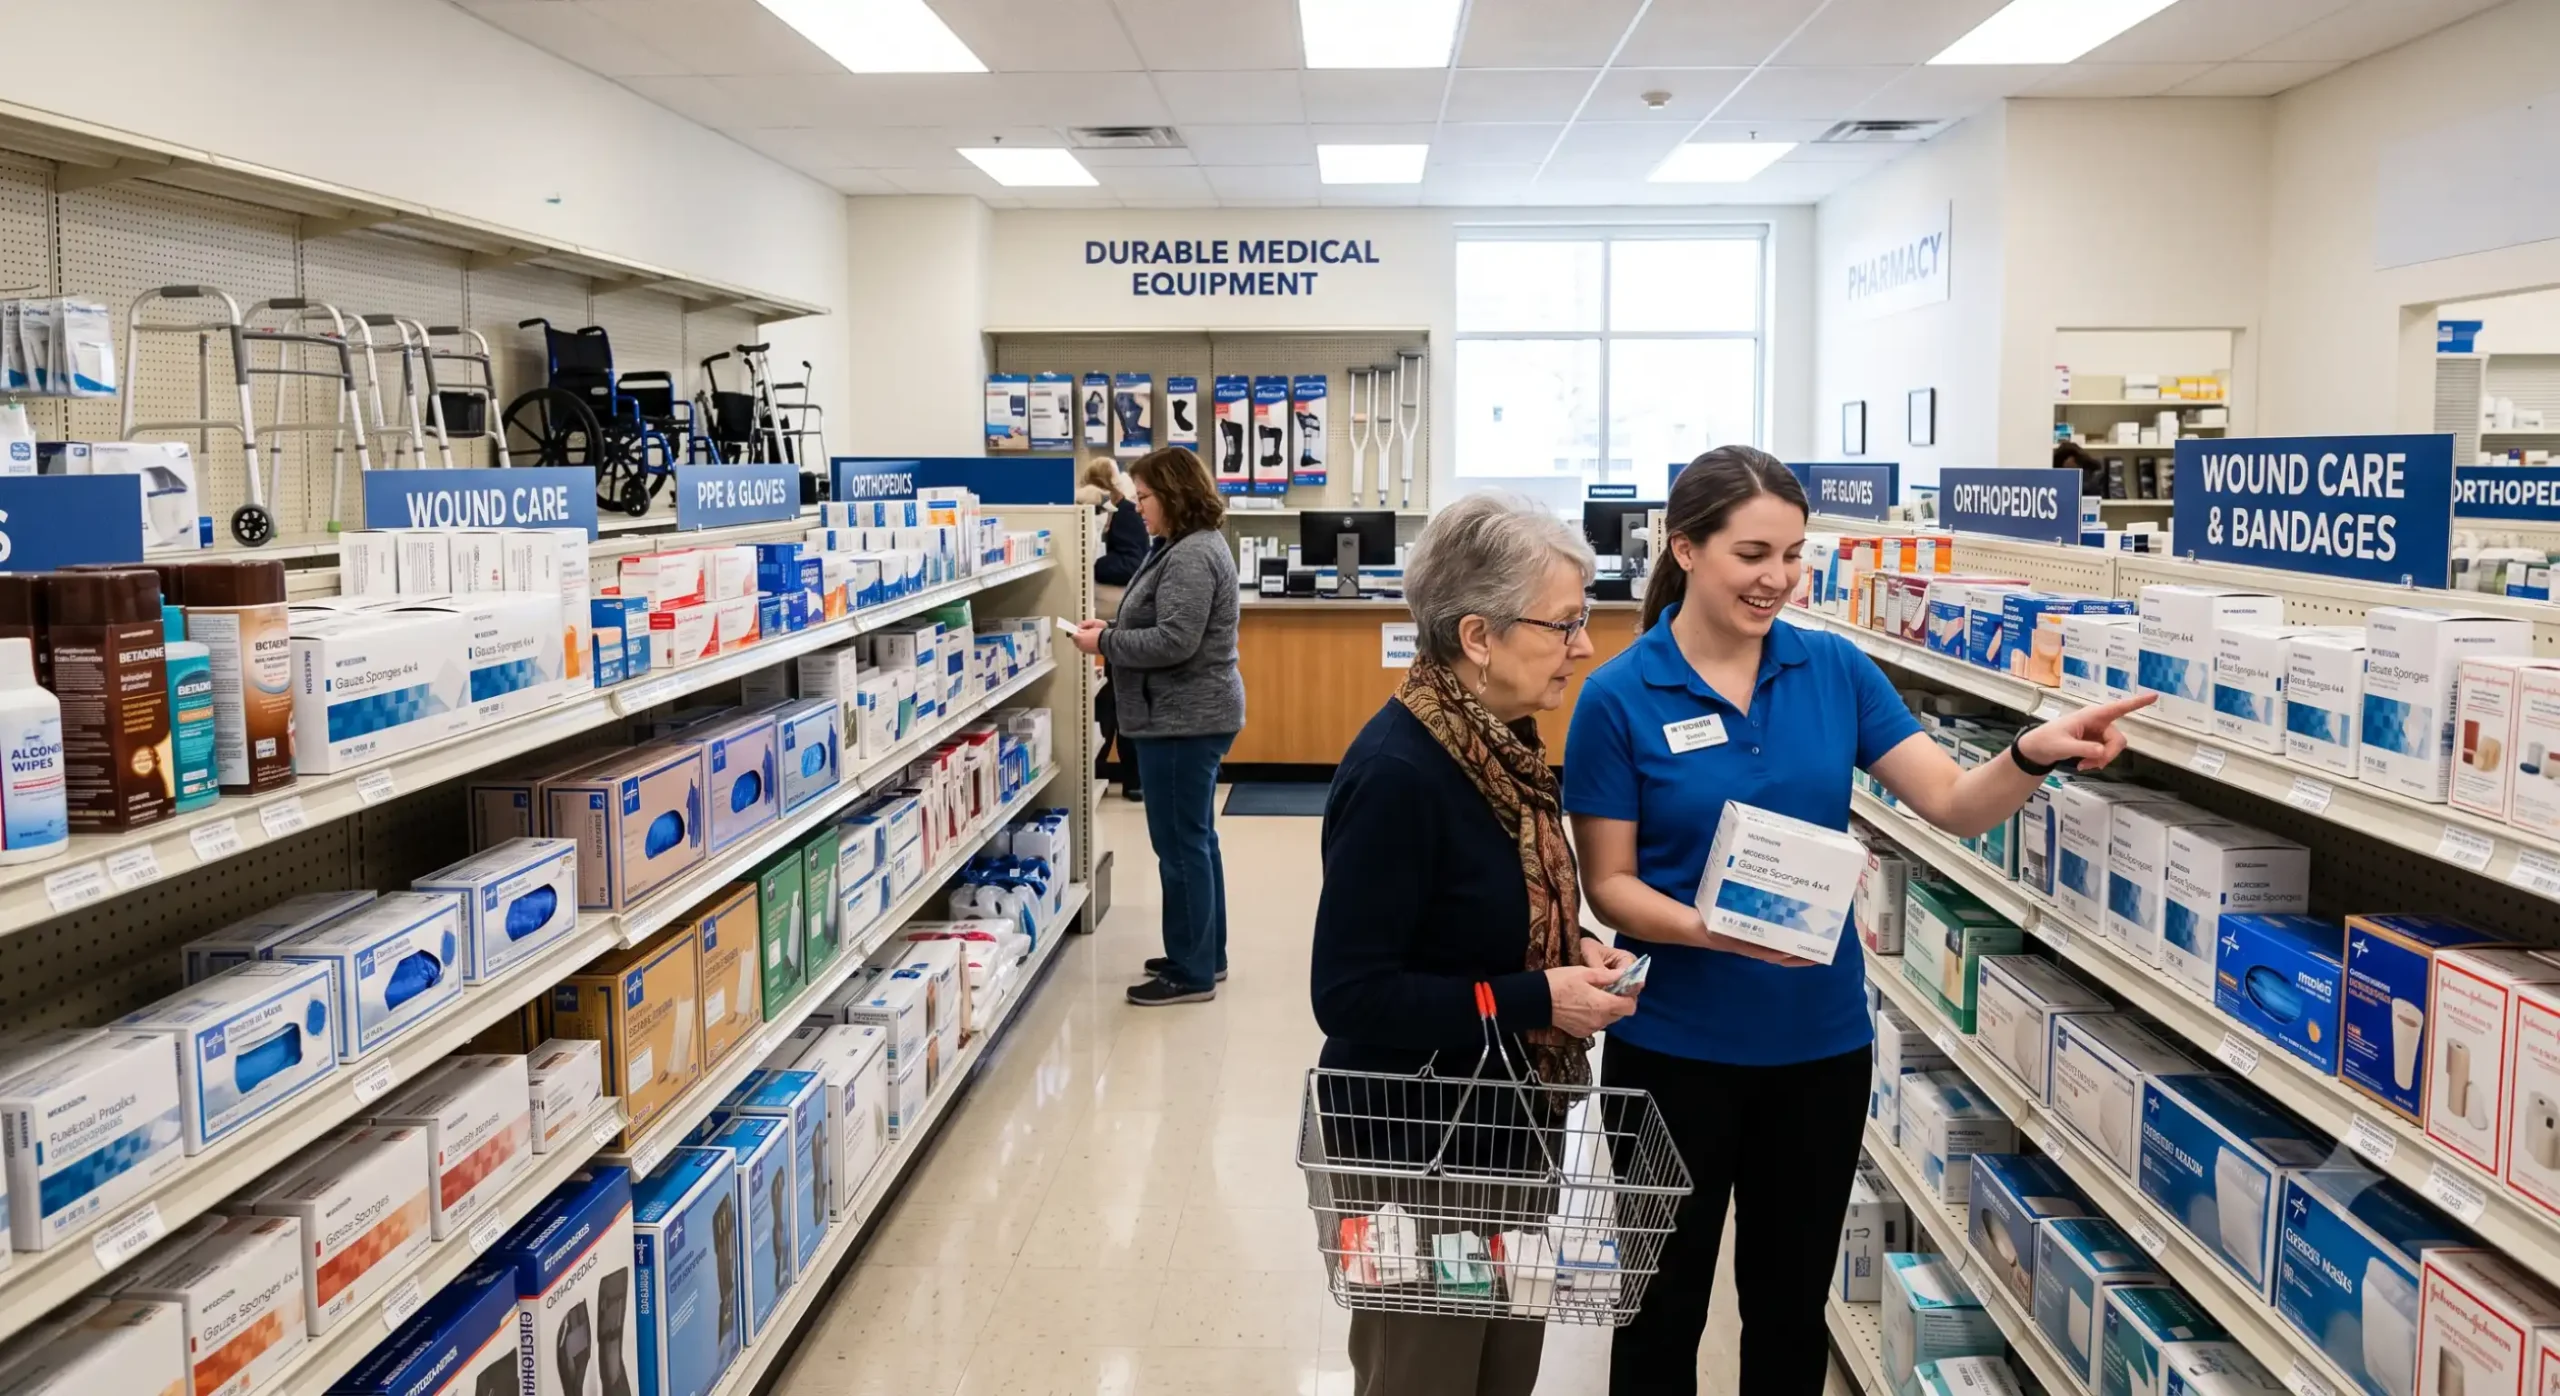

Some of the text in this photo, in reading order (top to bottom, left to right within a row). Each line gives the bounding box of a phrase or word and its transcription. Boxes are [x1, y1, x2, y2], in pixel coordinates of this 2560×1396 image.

[1085, 240, 1380, 265] DURABLE MEDICAL
[1849, 231, 1942, 300] PHARMACY
[1133, 272, 1318, 296] EQUIPMENT
[852, 473, 912, 498] ORTHOPEDICS
[2201, 453, 2406, 499] WOUND CARE
[698, 478, 786, 509] PPE & GLOVES
[1822, 478, 1873, 506] PPE GLOVES
[1953, 483, 2058, 520] ORTHOPEDICS
[406, 485, 570, 528] WOUND CARE
[2207, 506, 2397, 562] & BANDAGES
[119, 647, 165, 664] BETADINE
[335, 676, 364, 690] Gauze
[366, 667, 402, 684] Sponges
[2393, 667, 2430, 683] Sponges
[12, 758, 54, 773] WIPES
[1738, 859, 1831, 893] Gauze Sponges 4x4
[2232, 892, 2302, 904] Gauze Sponges
